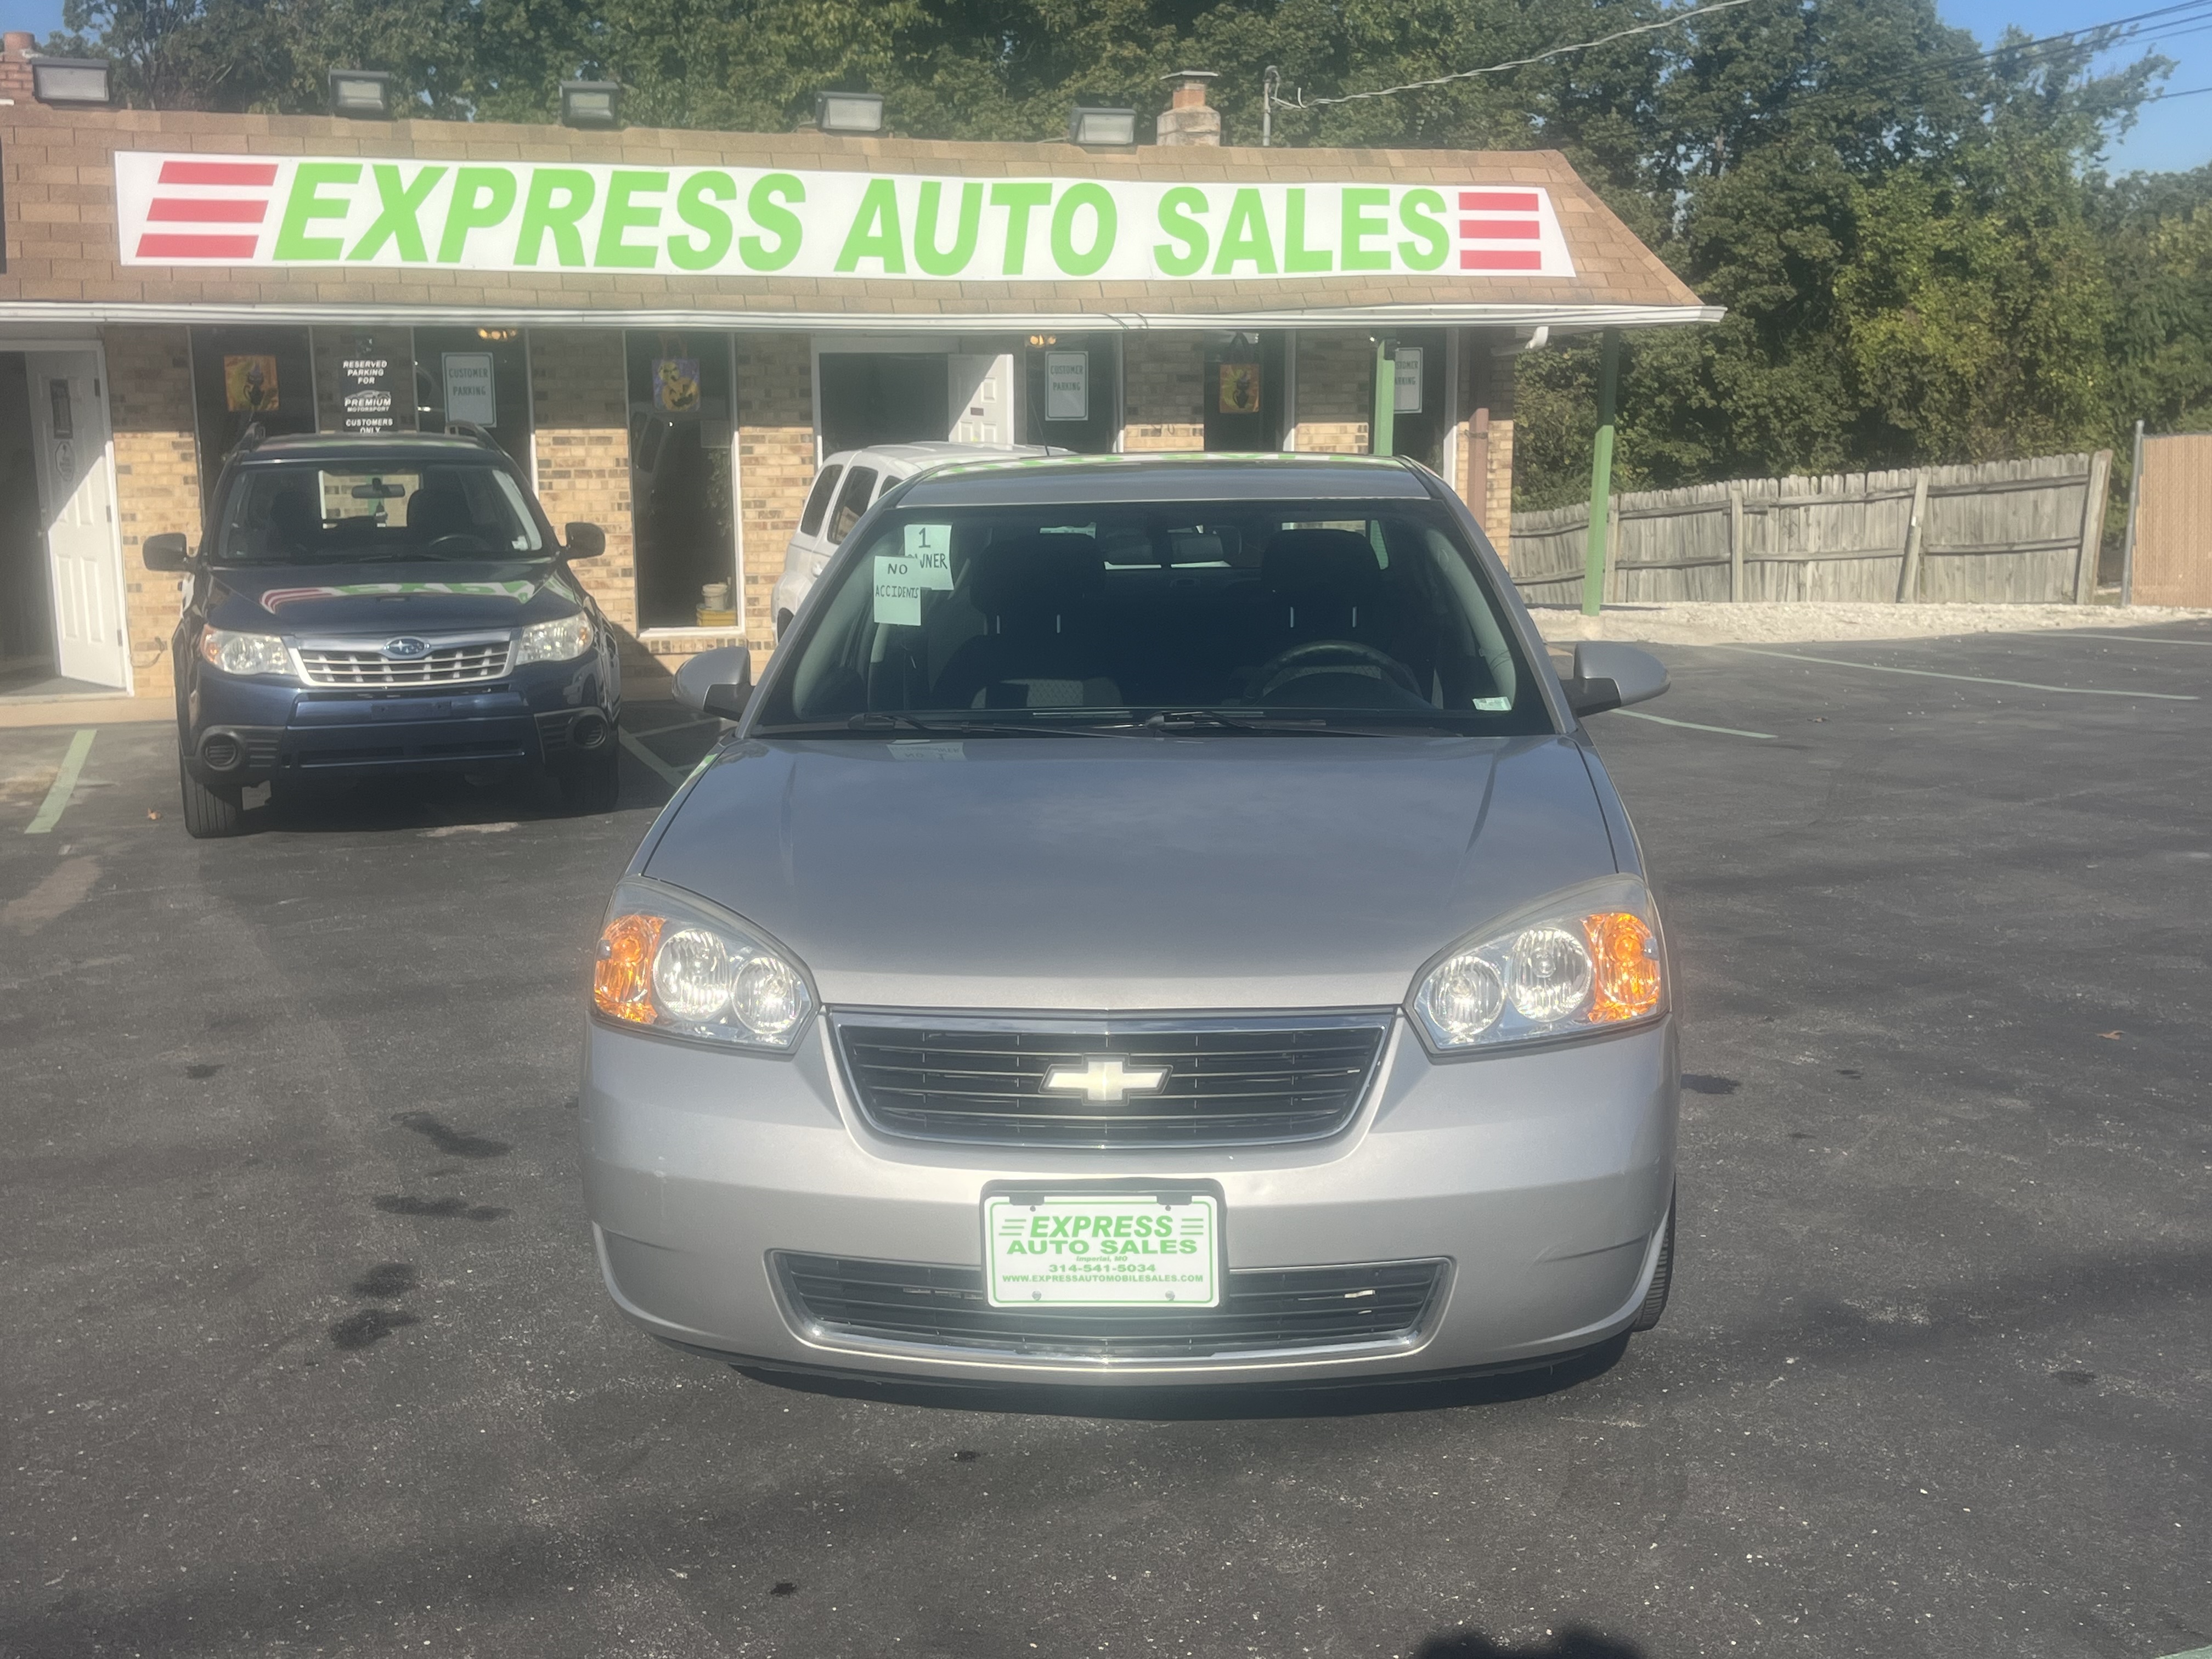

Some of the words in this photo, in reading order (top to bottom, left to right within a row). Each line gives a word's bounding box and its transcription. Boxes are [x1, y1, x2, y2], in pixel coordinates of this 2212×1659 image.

[273, 162, 806, 272] EXPRESS
[834, 178, 1118, 276] AUTO
[1153, 186, 1450, 276] SALES
[1395, 360, 1419, 369] STOMER
[347, 368, 384, 376] PARKING
[449, 368, 488, 378] CUSTOMER
[1051, 365, 1084, 375] CUSTOMER
[1395, 377, 1416, 385] ARKING
[453, 386, 486, 396] PARKING
[1053, 382, 1080, 391] PARKING
[345, 398, 391, 407] PREMIUM
[918, 527, 931, 548] 1
[907, 553, 948, 569] WNER
[887, 563, 908, 574] NO
[875, 585, 919, 599] ACCIDENTS
[1030, 1215, 1173, 1238] EXPRESS
[1006, 1239, 1090, 1255] AUTO
[1100, 1239, 1198, 1255] SALES
[1048, 1264, 1156, 1273] 314-541-5034
[1002, 1274, 1204, 1282] WWW.EXPRESSAUTOMOBILESALES.COM
